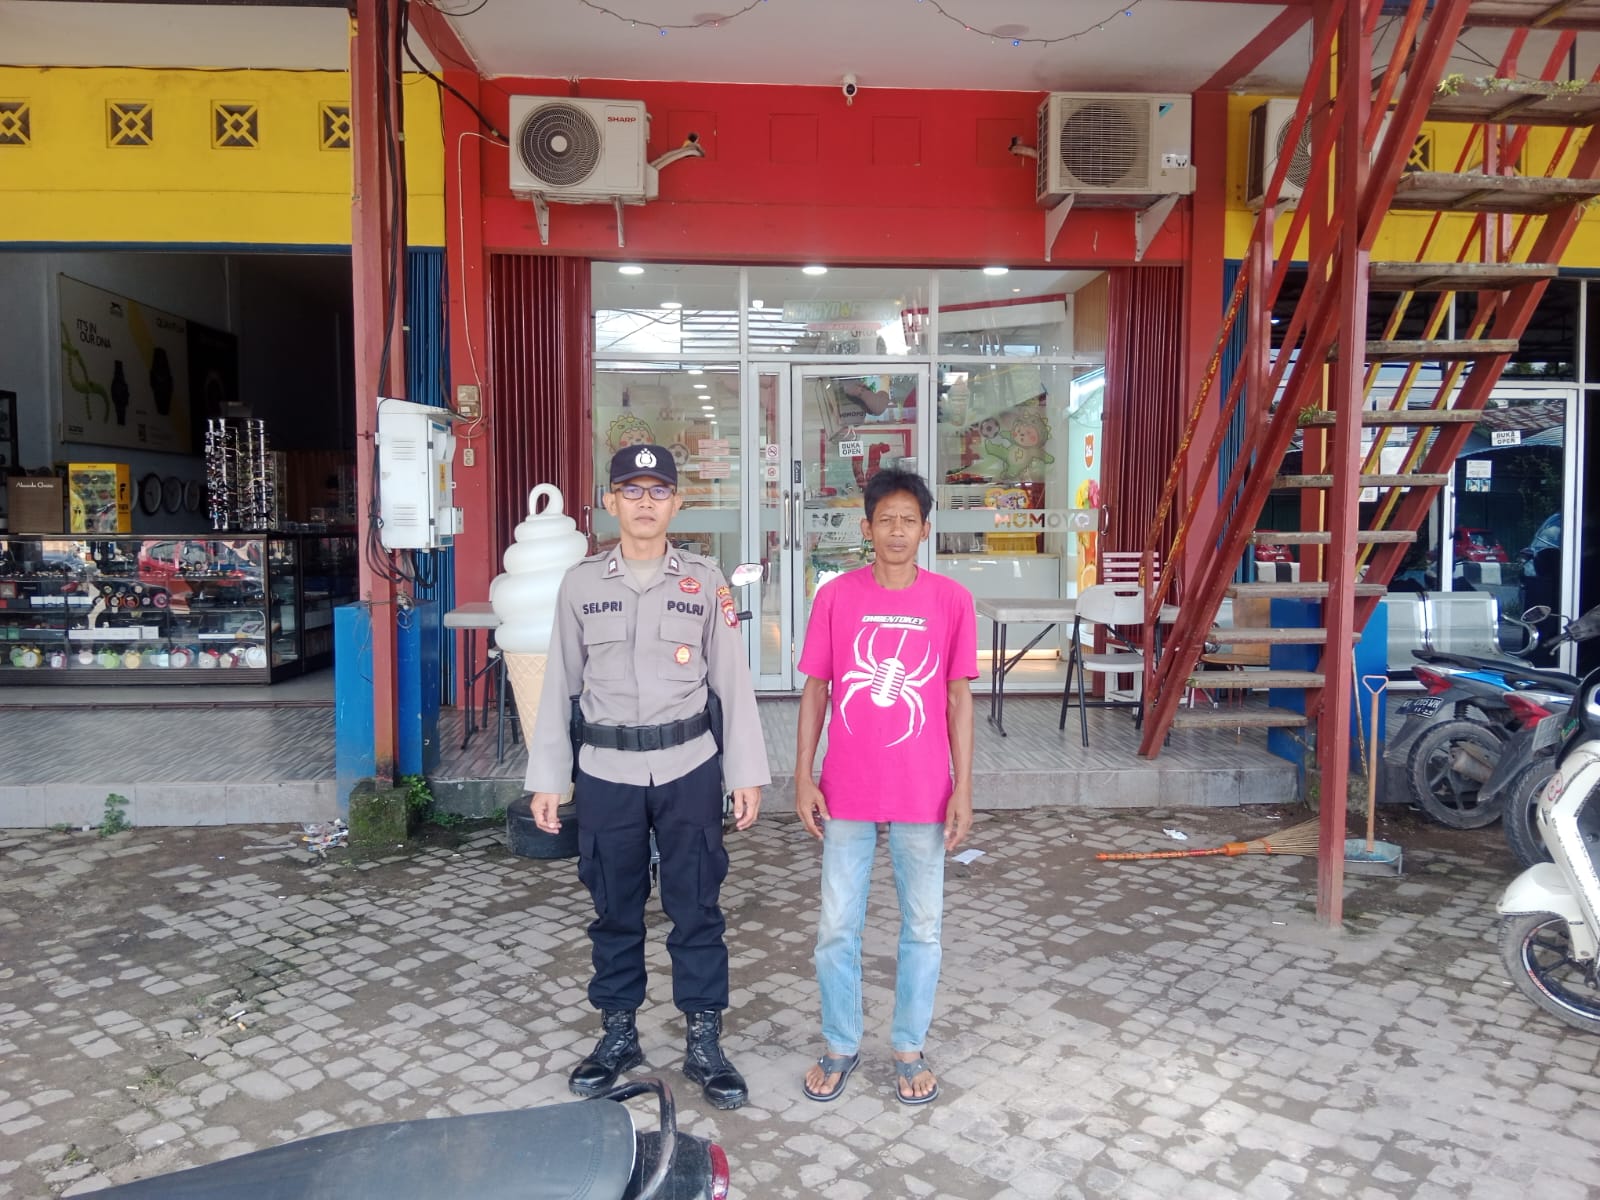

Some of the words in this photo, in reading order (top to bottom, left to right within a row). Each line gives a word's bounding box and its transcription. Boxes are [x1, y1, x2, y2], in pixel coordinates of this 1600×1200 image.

[80, 331, 95, 345] OUR
[96, 335, 112, 349] DNA
[994, 512, 1090, 529] MOMOYO
[582, 600, 623, 615] SELPRI
[667, 600, 705, 616] POLRI
